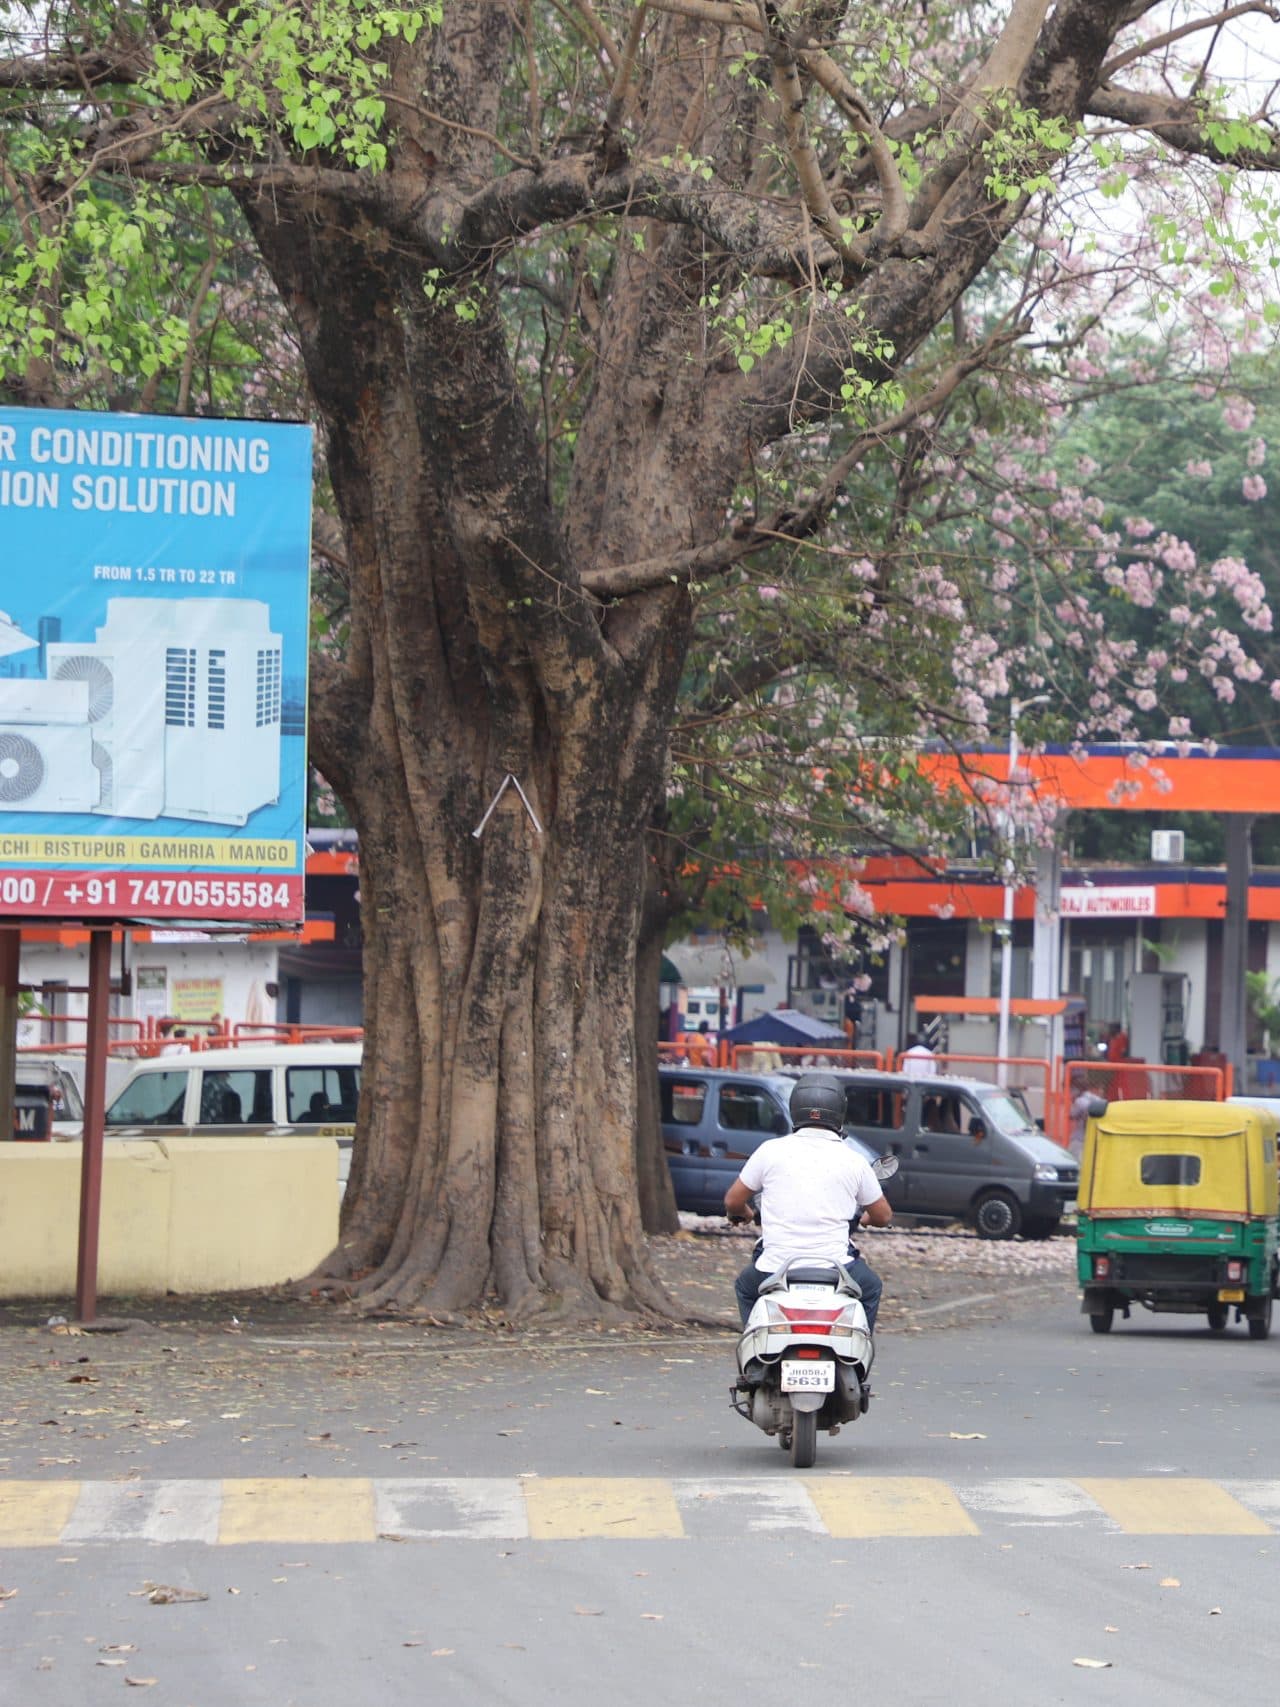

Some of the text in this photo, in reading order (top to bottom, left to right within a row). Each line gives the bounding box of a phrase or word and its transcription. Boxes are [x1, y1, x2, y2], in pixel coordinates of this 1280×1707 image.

[31, 427, 270, 474] CONDITIONING
[71, 474, 236, 517] SOLUTION
[93, 565, 236, 585] FROM 1.5 TR TO 22 TR
[44, 841, 126, 857] BISTUPUR
[140, 843, 215, 860] GAMHRIA
[229, 846, 289, 861] MANGO
[0, 877, 36, 904] 00
[63, 879, 117, 905] +91
[128, 879, 290, 908] 7470555584
[786, 1377, 829, 1386] 5631
